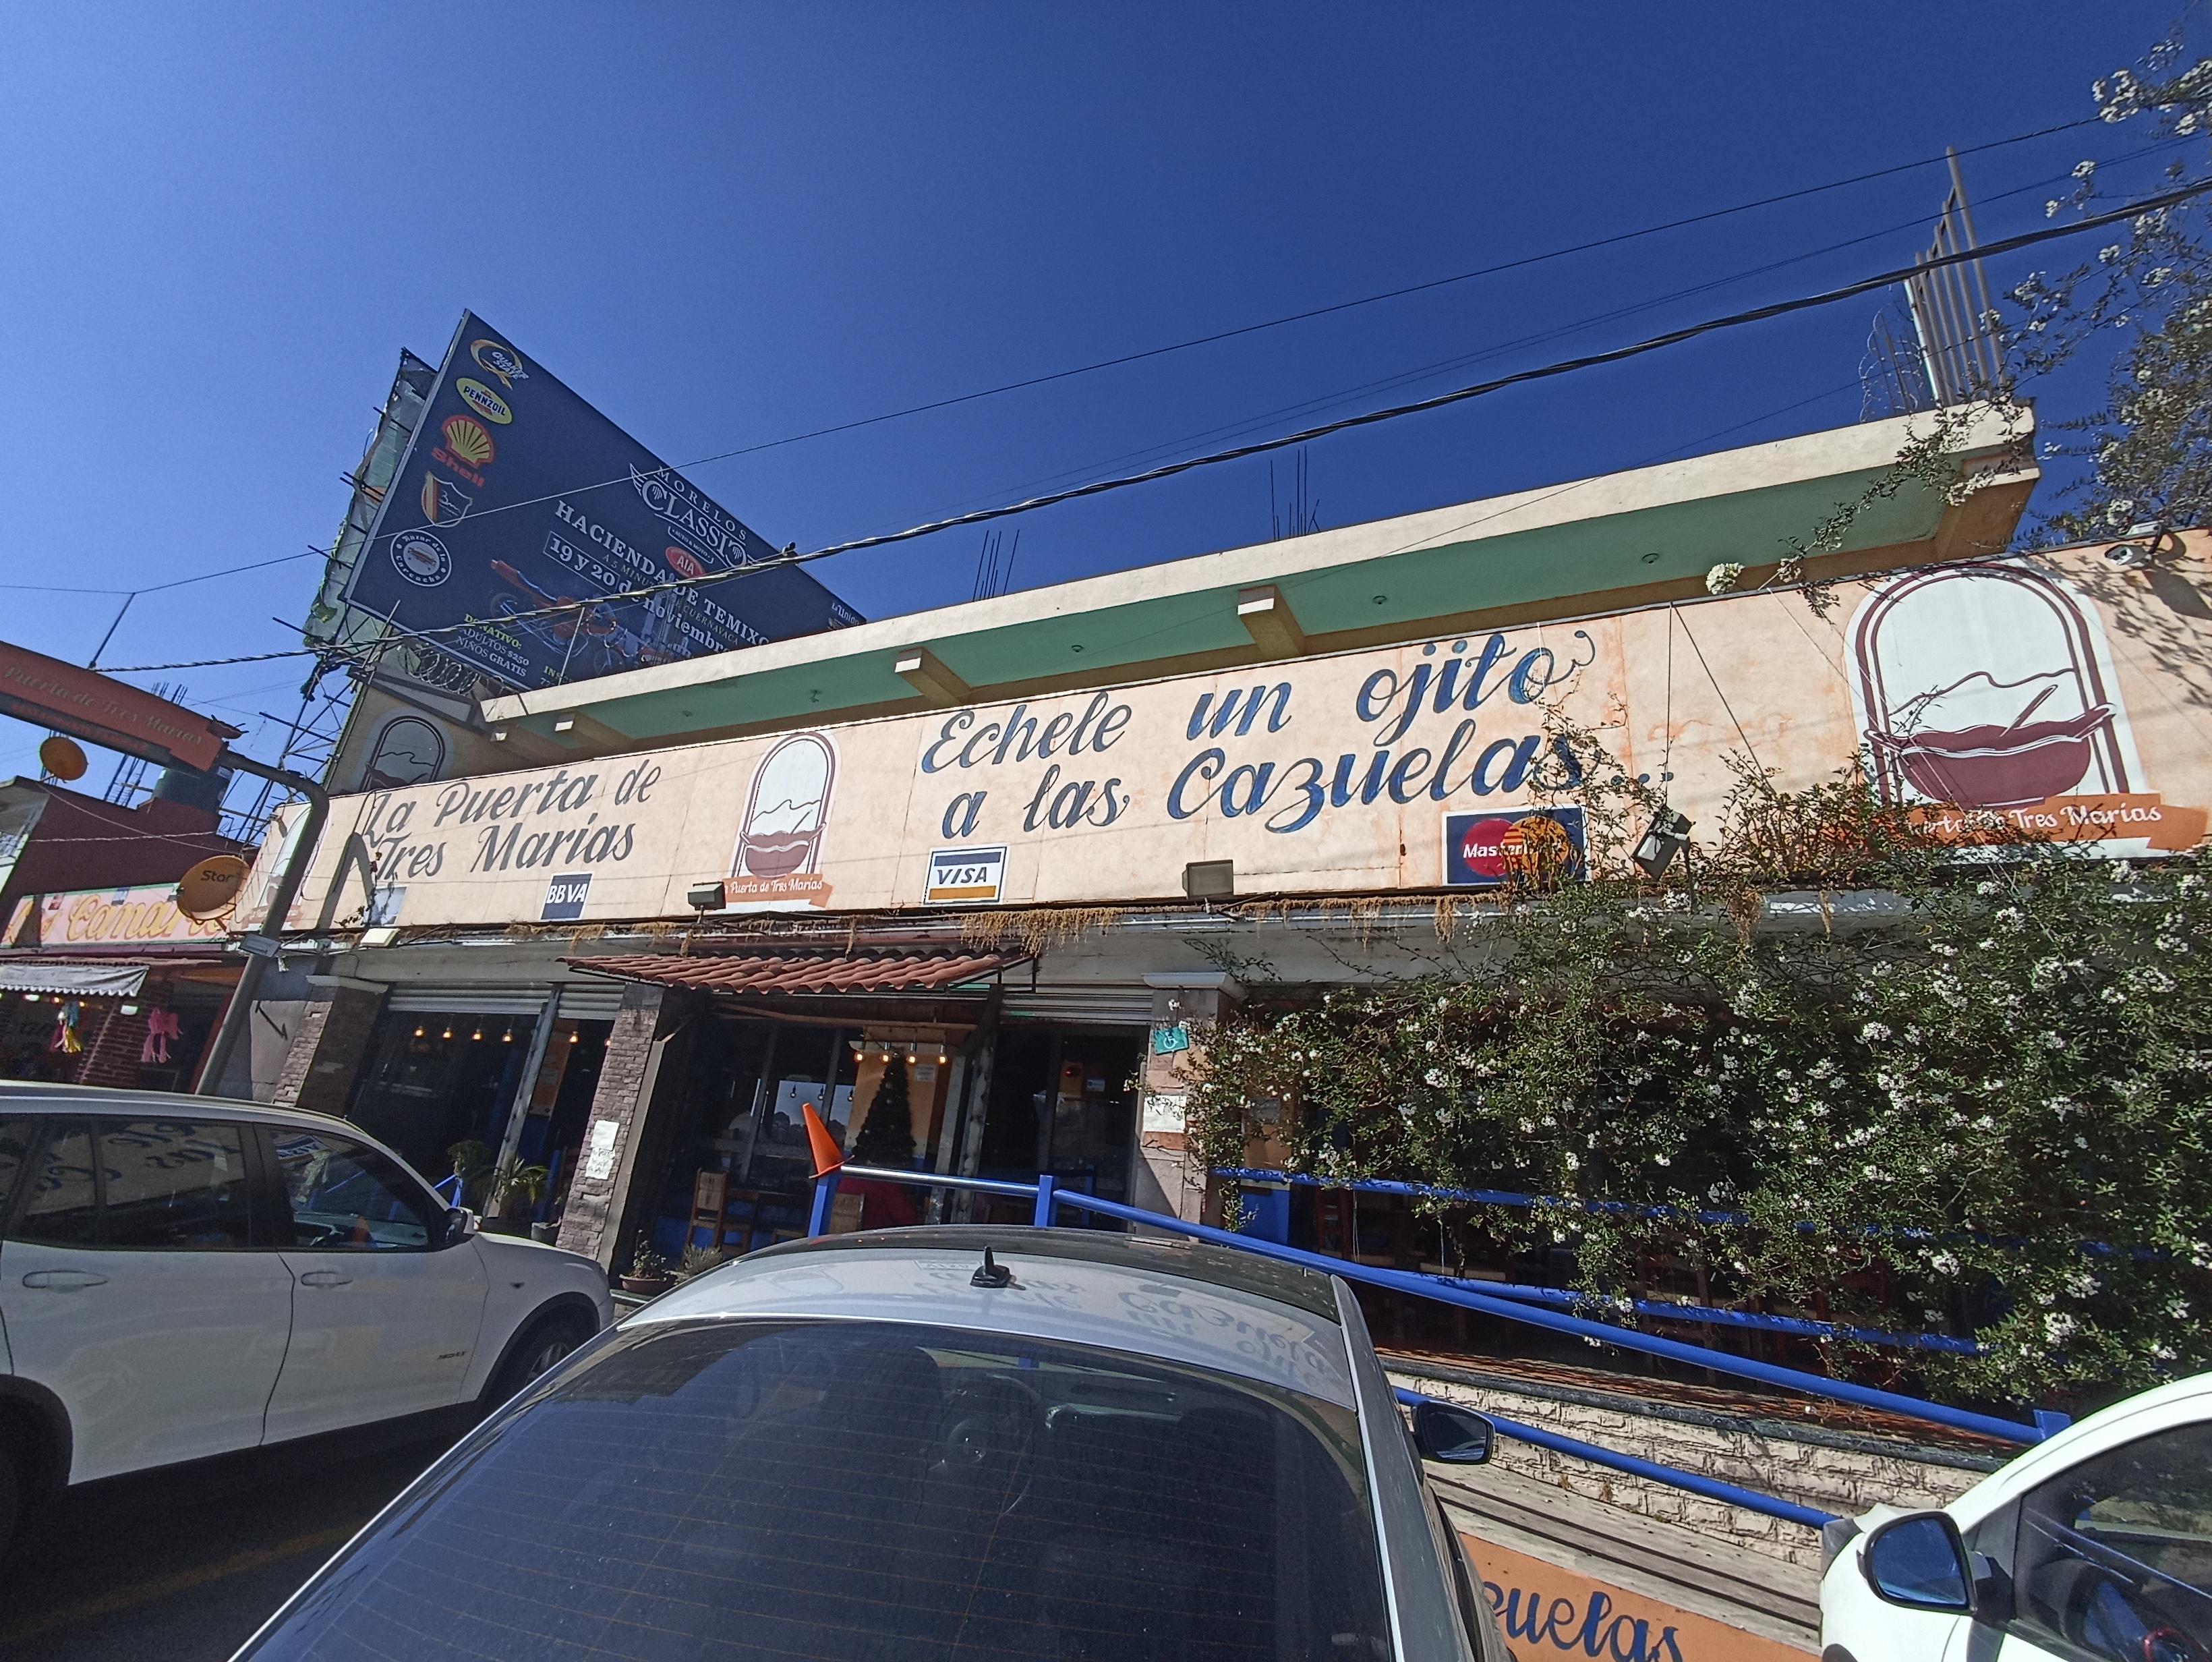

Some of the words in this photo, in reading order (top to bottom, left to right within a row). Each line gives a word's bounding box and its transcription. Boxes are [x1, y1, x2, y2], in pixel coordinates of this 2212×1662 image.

[463, 385, 505, 416] PENNZOIL
[431, 447, 486, 488] Shell
[658, 465, 747, 540] MORELOS
[642, 480, 747, 568] CLASSIC
[555, 500, 666, 585] HACIENDA
[675, 530, 689, 542] AUTO
[693, 545, 708, 556] MOTO
[550, 538, 573, 562] 19
[574, 554, 589, 571] y
[591, 564, 616, 586] 20
[676, 555, 695, 574] AIA
[489, 653, 527, 677] GRATIS
[507, 650, 529, 666] $250
[921, 691, 1132, 774] Echele
[1186, 681, 1292, 741] un
[1356, 630, 1596, 747] ojito
[364, 792, 417, 849] La
[433, 770, 599, 828] Puerta
[614, 759, 661, 806] de
[941, 791, 988, 839] a
[1023, 764, 1130, 832] las
[2008, 807, 2058, 829] Tres
[375, 831, 448, 881] Tres
[200, 870, 236, 882] Star
[730, 880, 757, 894] Puerta
[759, 881, 769, 892] de
[771, 878, 787, 893] Tres
[936, 867, 987, 885] VISA
[546, 883, 587, 905] BBVA
